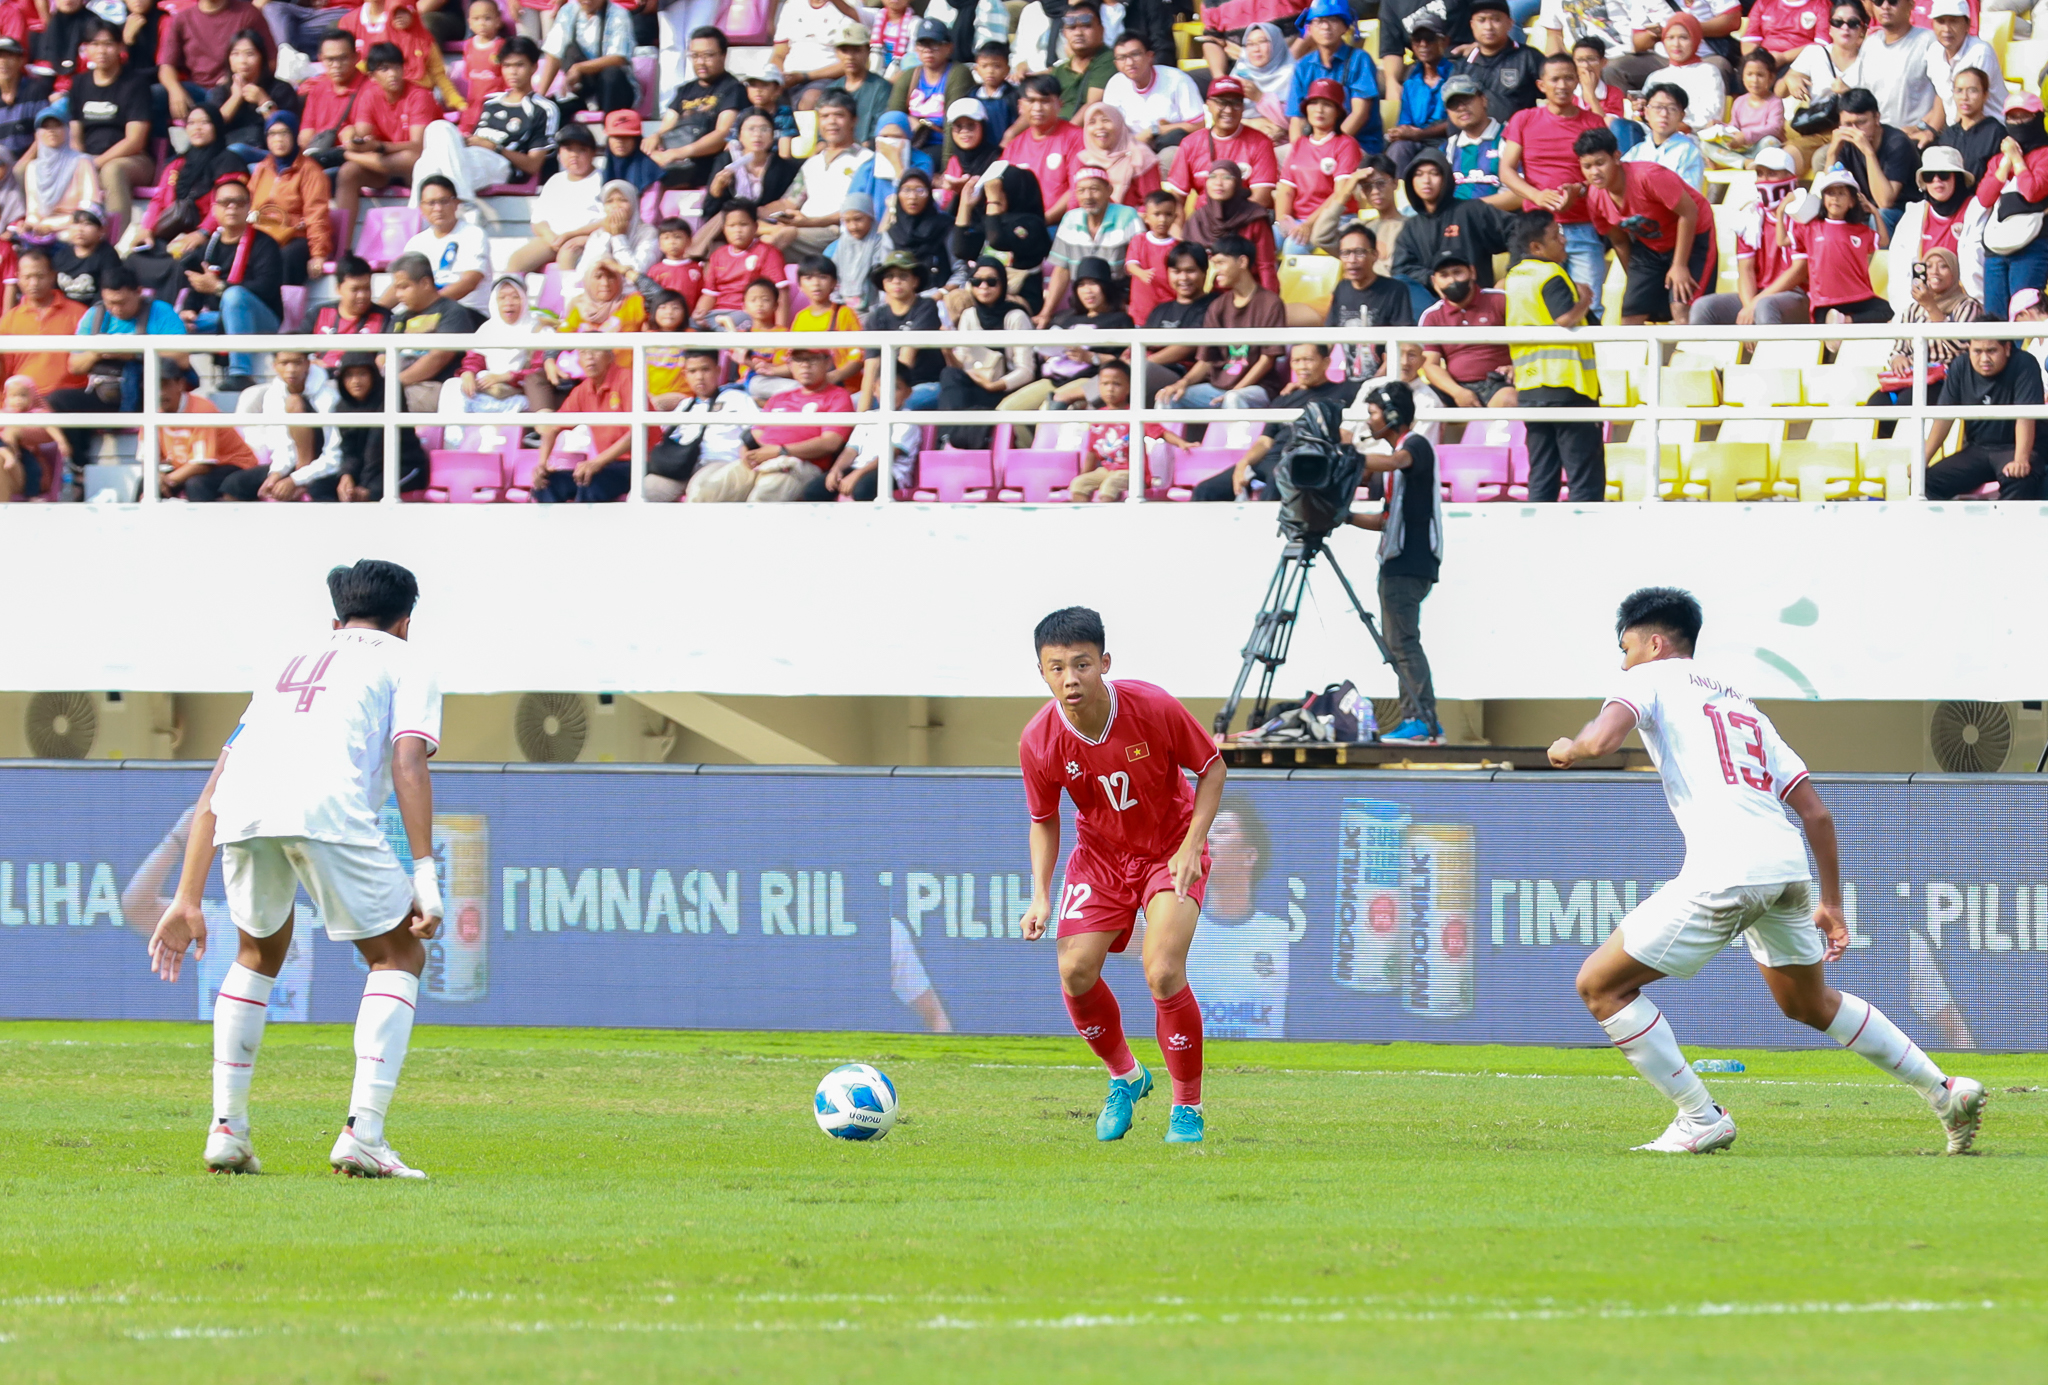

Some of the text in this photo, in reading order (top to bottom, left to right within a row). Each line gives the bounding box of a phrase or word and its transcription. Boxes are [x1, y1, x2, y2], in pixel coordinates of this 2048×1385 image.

[275, 649, 338, 713] 4
[1703, 703, 1774, 792] 13
[1098, 771, 1138, 811] 12
[760, 871, 857, 935] RIIL
[907, 872, 1066, 938] PILIH
[1060, 883, 1092, 920] 12
[1336, 826, 1361, 981] INDOMILK
[1410, 851, 1431, 1009] INDOMILK
[1491, 879, 1665, 945] TIMN
[849, 1112, 881, 1124] molten
